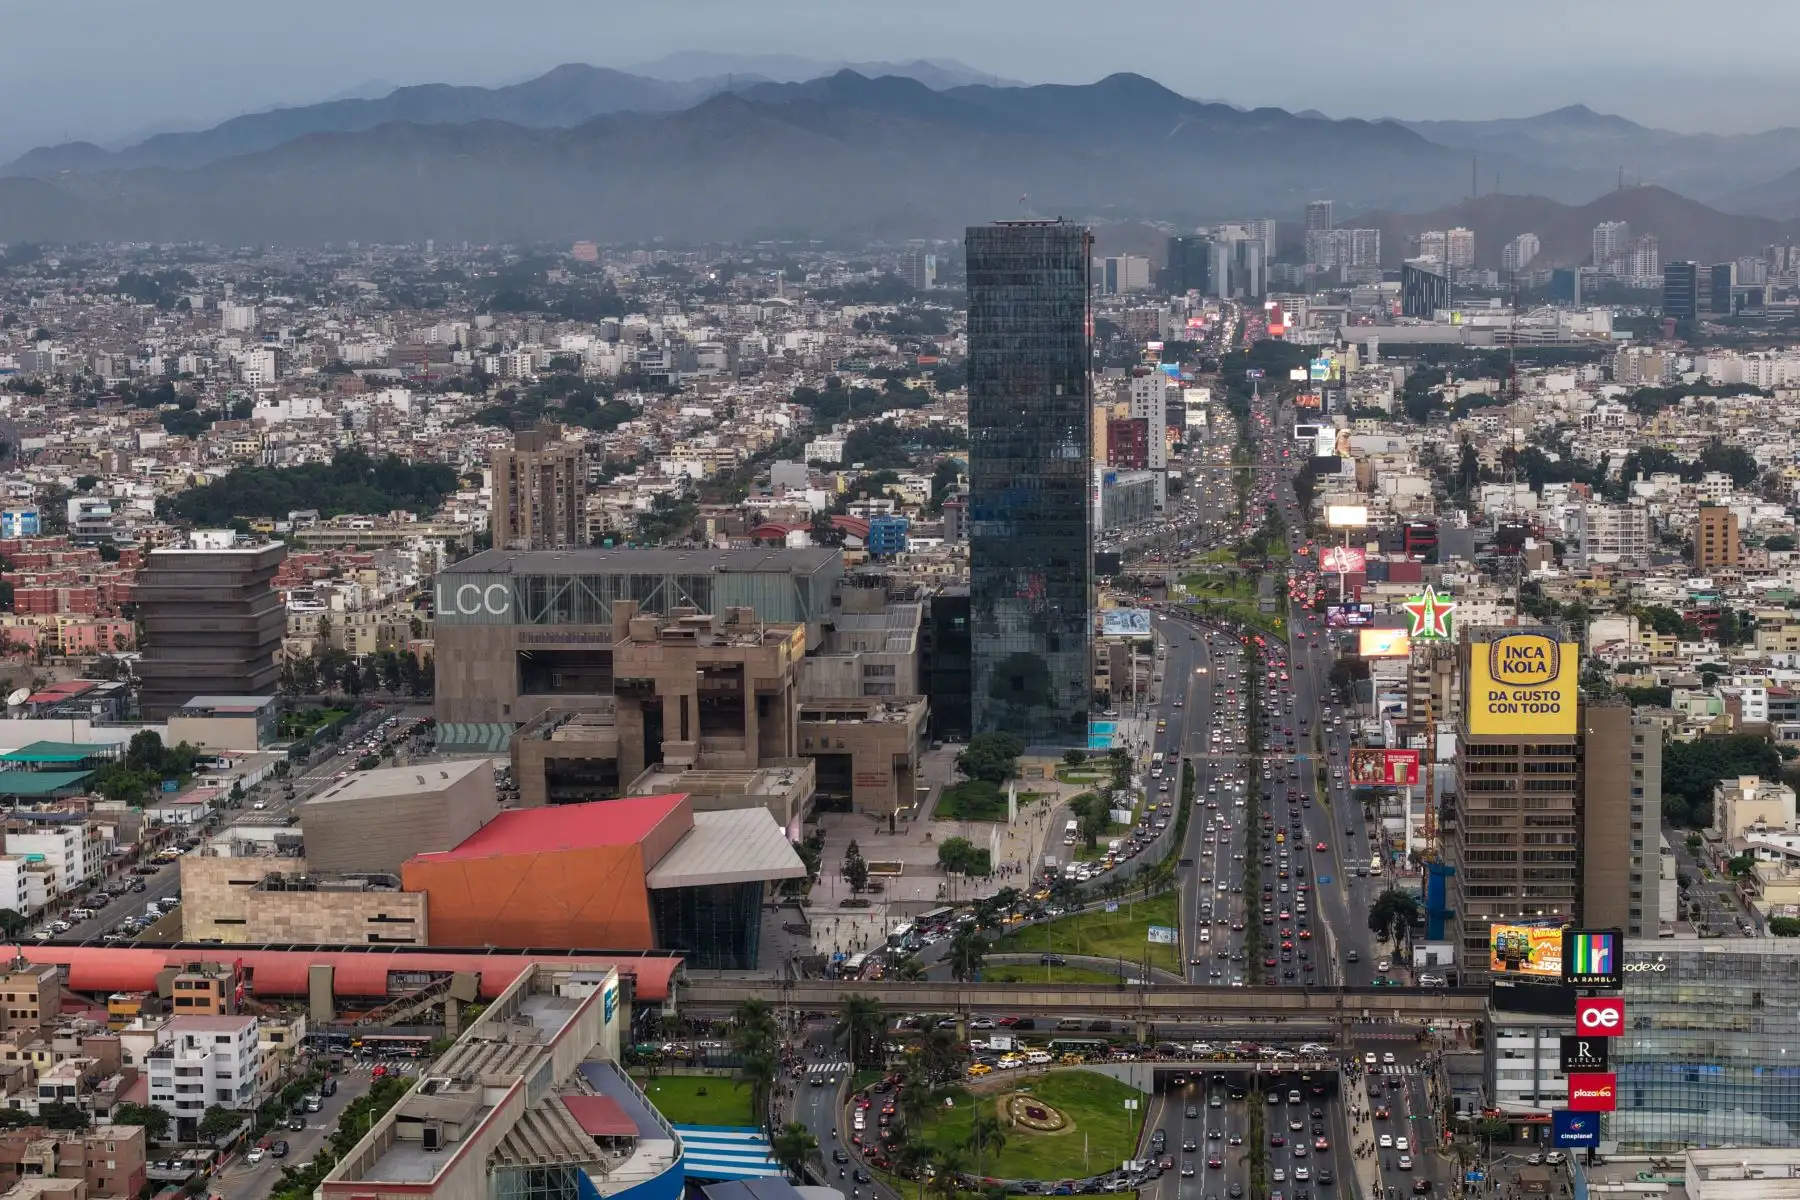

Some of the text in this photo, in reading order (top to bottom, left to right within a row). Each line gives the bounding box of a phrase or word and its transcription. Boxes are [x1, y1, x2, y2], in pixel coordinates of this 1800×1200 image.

[437, 584, 509, 615] LCC
[1505, 646, 1545, 659] INCA
[1503, 660, 1547, 673] KOLA
[1488, 691, 1560, 701] DA GUSTO
[1488, 703, 1560, 713] CON TODO
[1578, 1041, 1592, 1057] R
